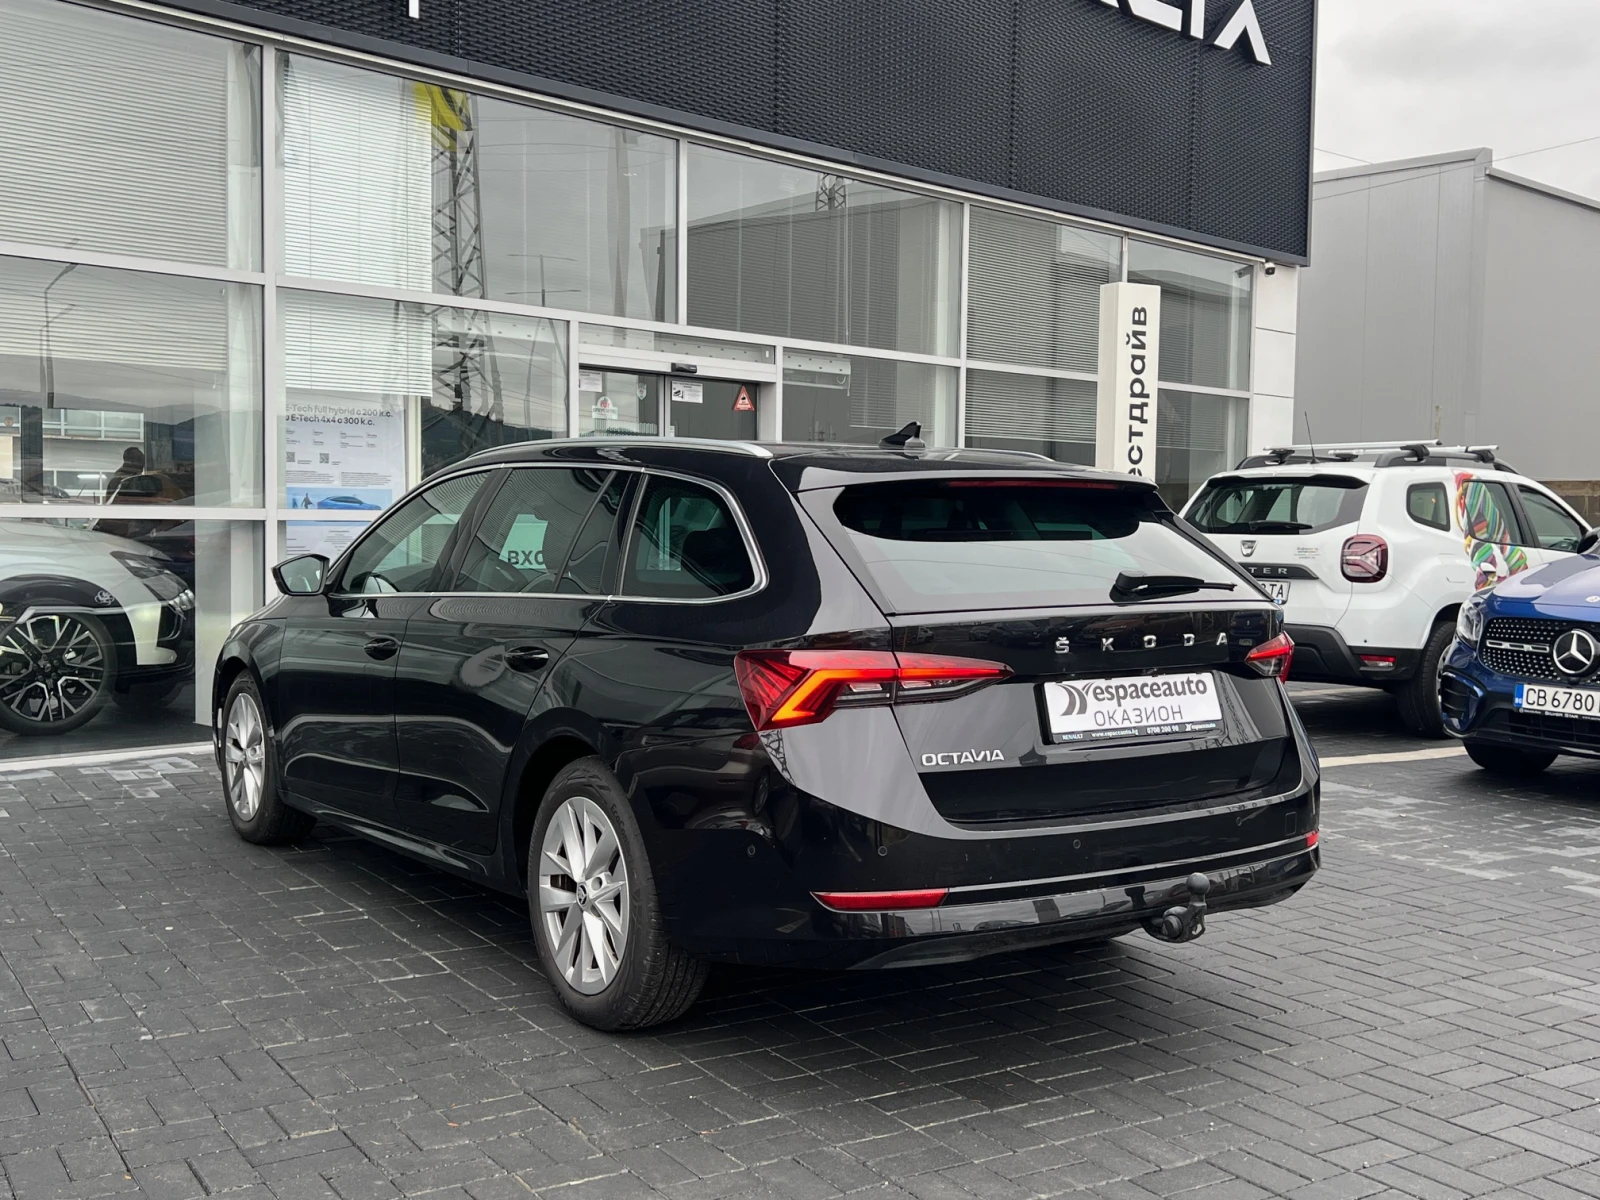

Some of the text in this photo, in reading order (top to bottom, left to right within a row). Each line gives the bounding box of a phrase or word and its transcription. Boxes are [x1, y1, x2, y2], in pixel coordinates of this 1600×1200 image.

[291, 413, 320, 423] E-Tech
[343, 416, 360, 425] 300
[314, 404, 328, 414] full
[328, 405, 355, 416] hybrid
[362, 408, 378, 416] 200
[1054, 632, 1228, 654] ŠKODA
[1092, 675, 1208, 707] espaceauto
[1526, 688, 1547, 706] CB
[1551, 691, 1594, 711] 6780
[1094, 704, 1183, 727] ОКАЗИОН
[921, 748, 1005, 766] OCTAVIA
